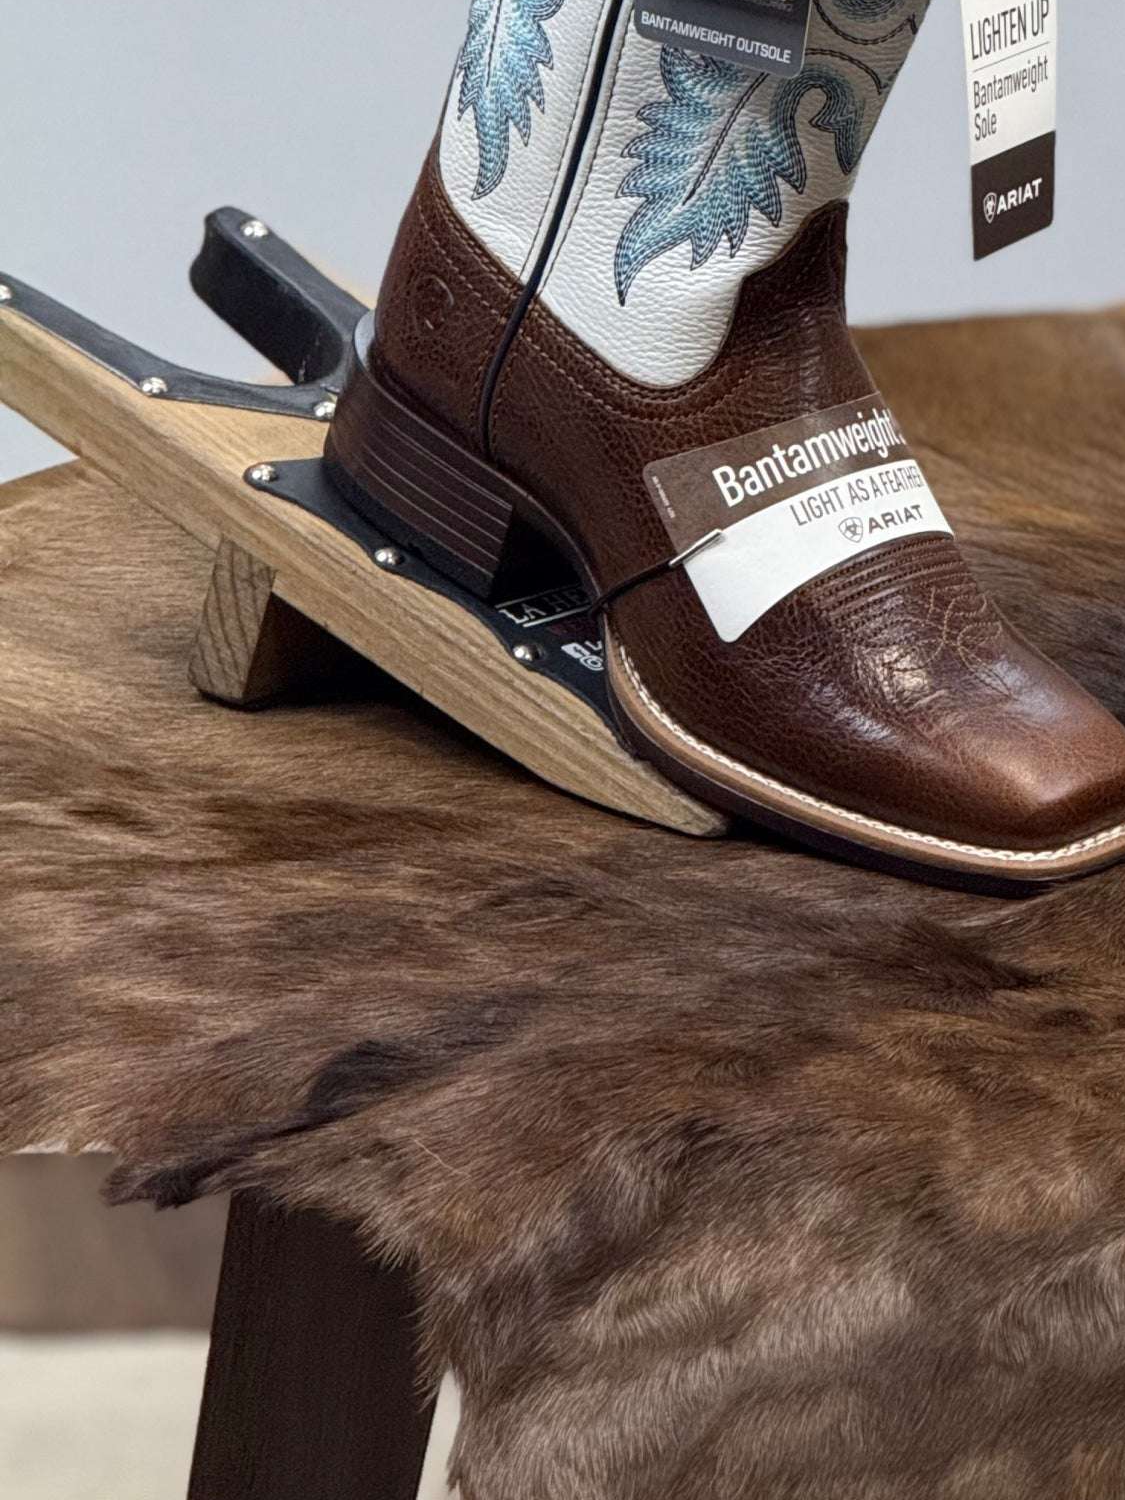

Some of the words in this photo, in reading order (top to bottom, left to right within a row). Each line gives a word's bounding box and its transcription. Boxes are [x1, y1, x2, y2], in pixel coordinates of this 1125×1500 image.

[641, 10, 735, 48] BANTAMWEIGHT
[736, 37, 792, 64] OUTSOLE
[970, 3, 1027, 60] LIGHTEN
[973, 55, 1048, 110] Bantamweight
[974, 108, 997, 142] Sole
[996, 177, 1043, 215] ARIAT
[790, 486, 845, 526] LIGHT
[848, 478, 870, 505] AS
[869, 475, 883, 498] A
[868, 504, 924, 534] ARIAT
